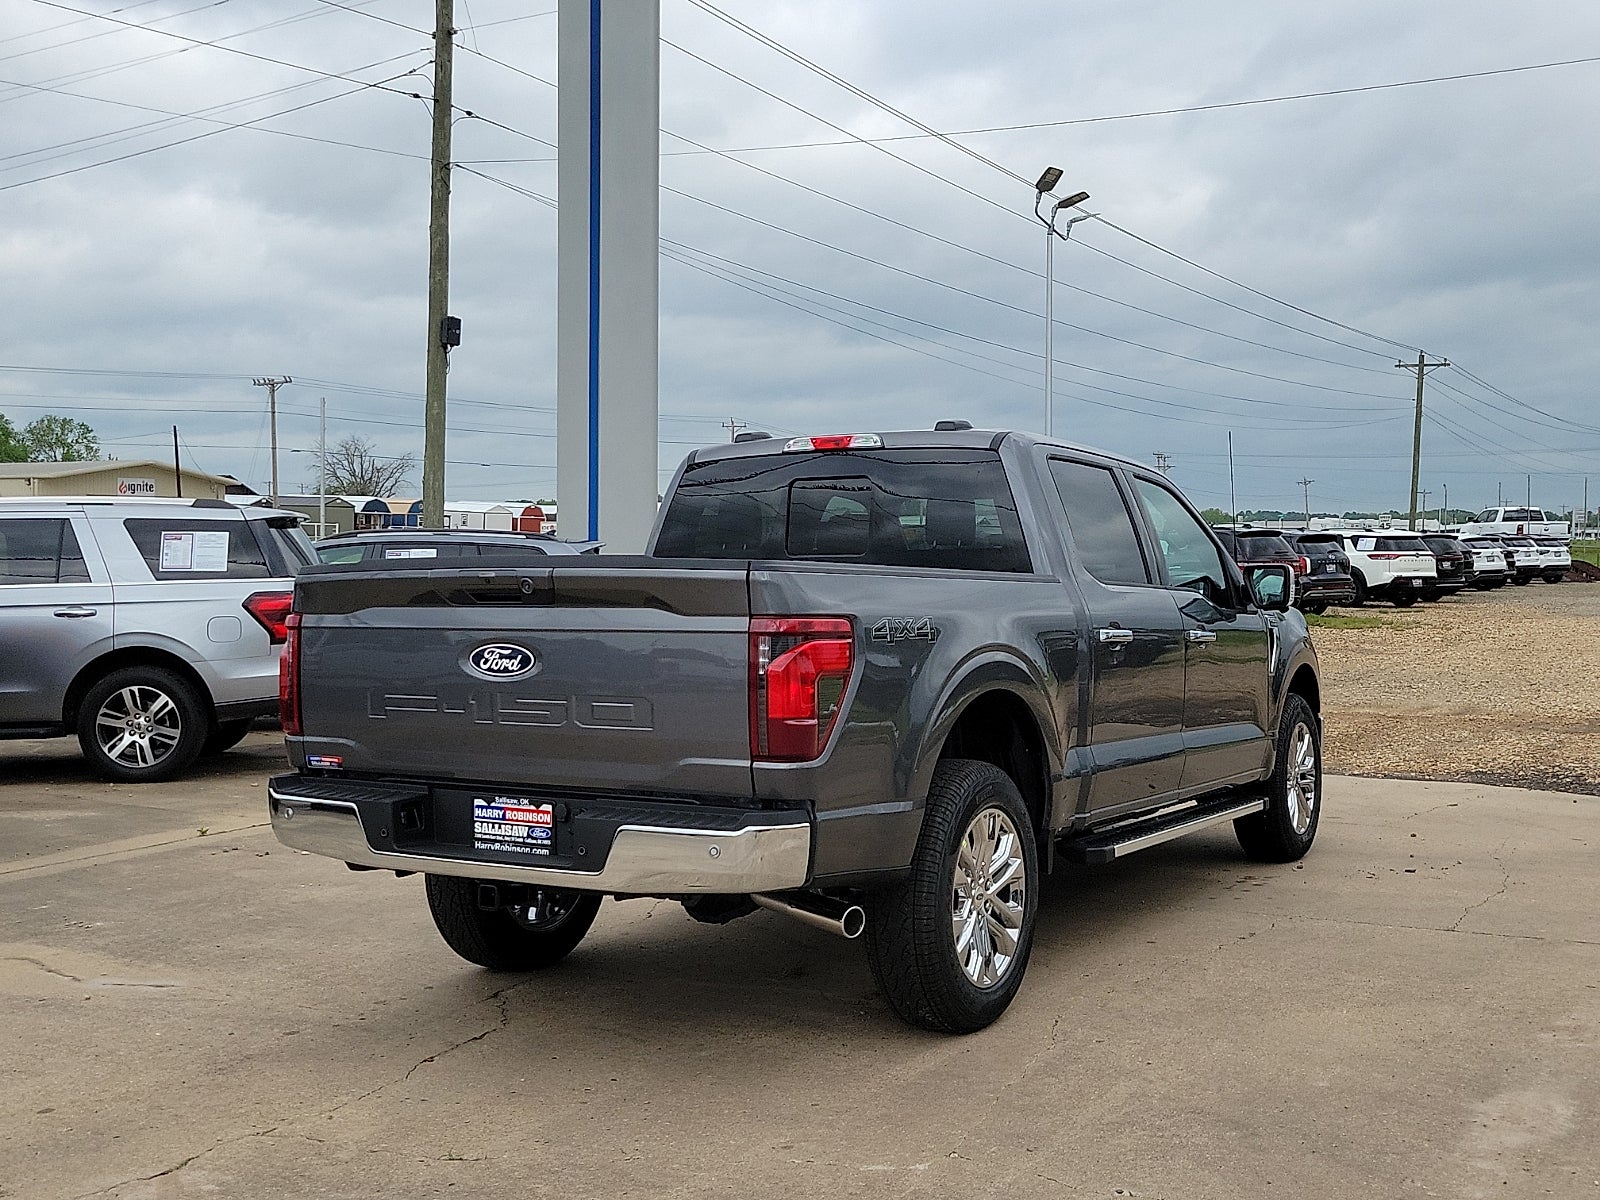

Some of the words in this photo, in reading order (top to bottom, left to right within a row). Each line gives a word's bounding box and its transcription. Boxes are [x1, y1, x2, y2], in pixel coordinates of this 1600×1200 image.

[127, 480, 154, 494] ignite
[480, 648, 522, 670] Ford
[367, 691, 654, 731] F-150
[475, 807, 504, 819] HARRY
[505, 810, 551, 823] ROBINSON
[474, 821, 529, 837] SALLISAW
[474, 840, 550, 856] HarryRobinson.com
